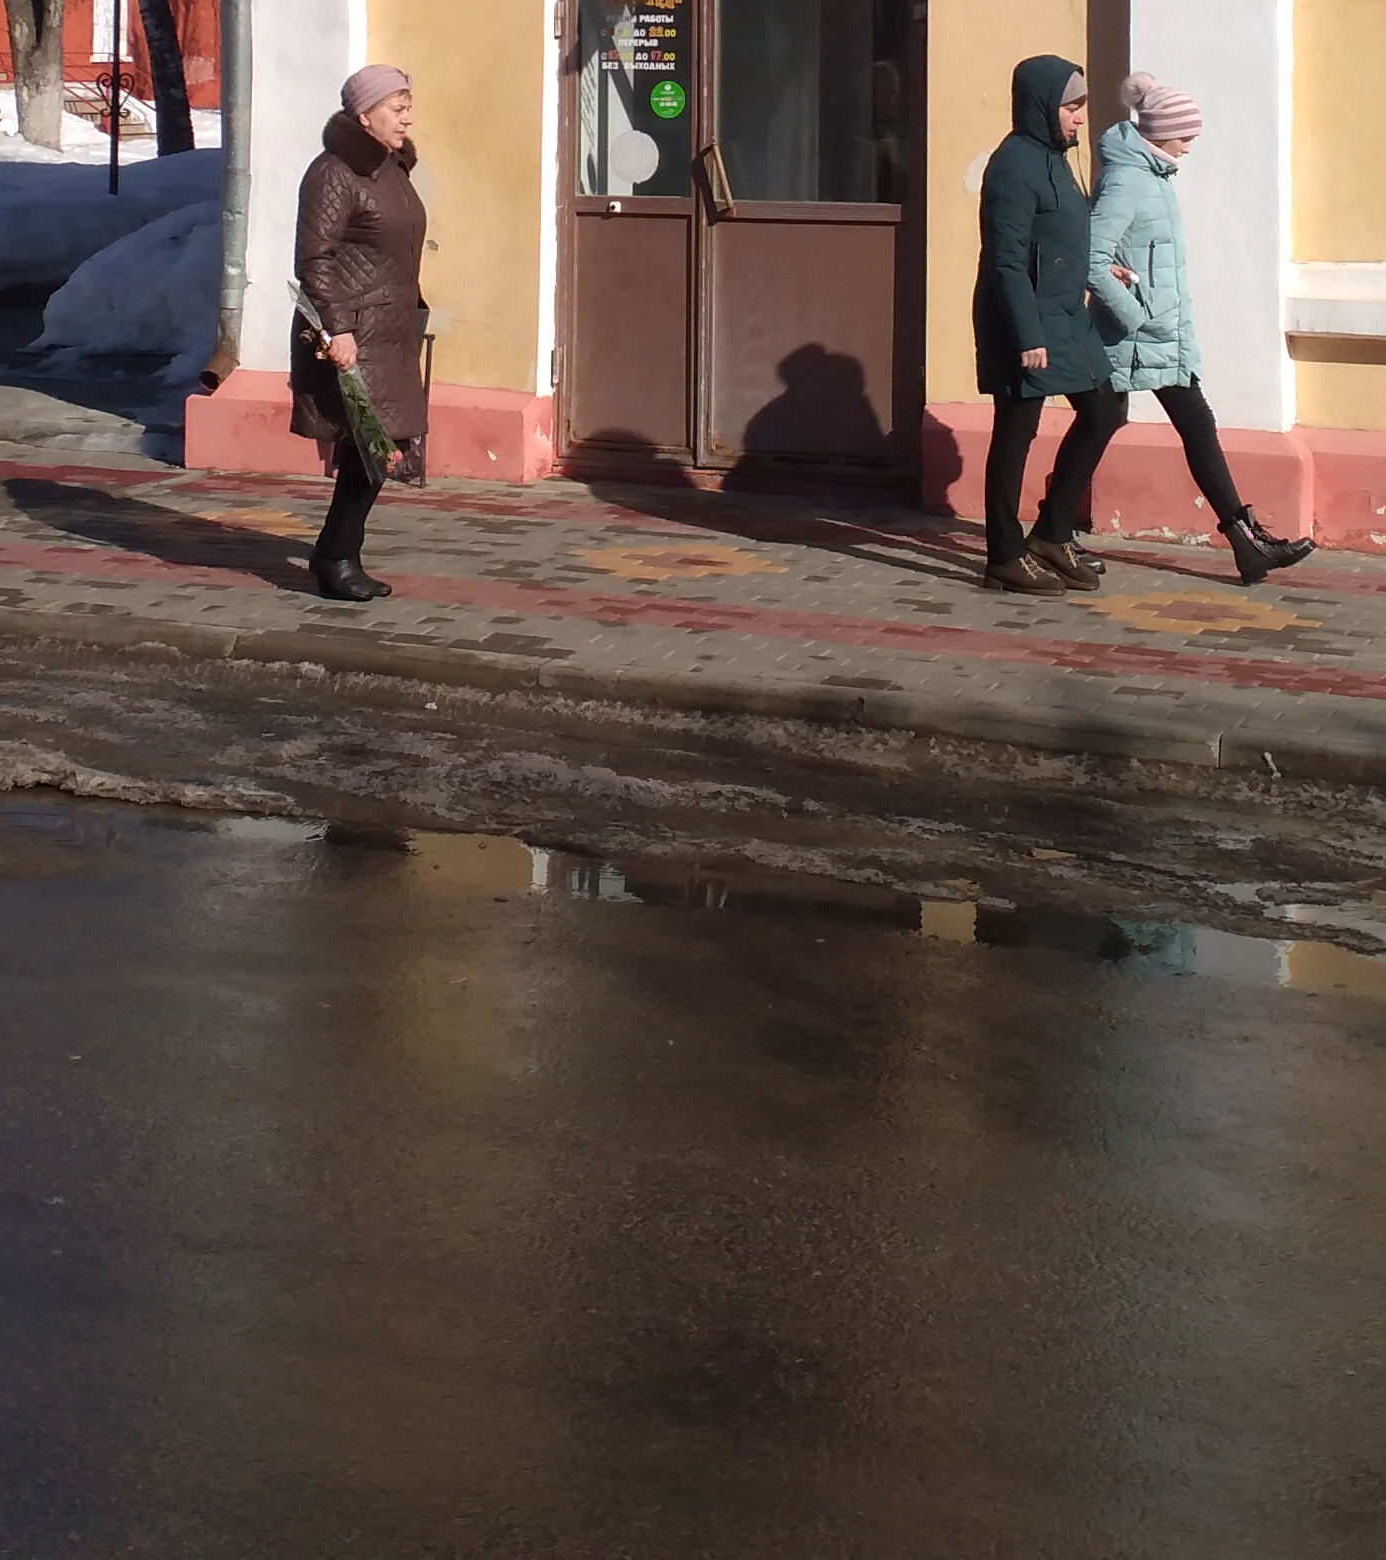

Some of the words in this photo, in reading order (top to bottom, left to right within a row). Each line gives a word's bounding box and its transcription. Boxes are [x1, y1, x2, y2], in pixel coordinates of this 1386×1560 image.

[639, 14, 674, 23] РАБОТЫ
[618, 38, 659, 47] ПЕРЕРЫВ
[601, 61, 619, 70] БЕЗ
[623, 61, 676, 71] ВЫХОДНЫХ
